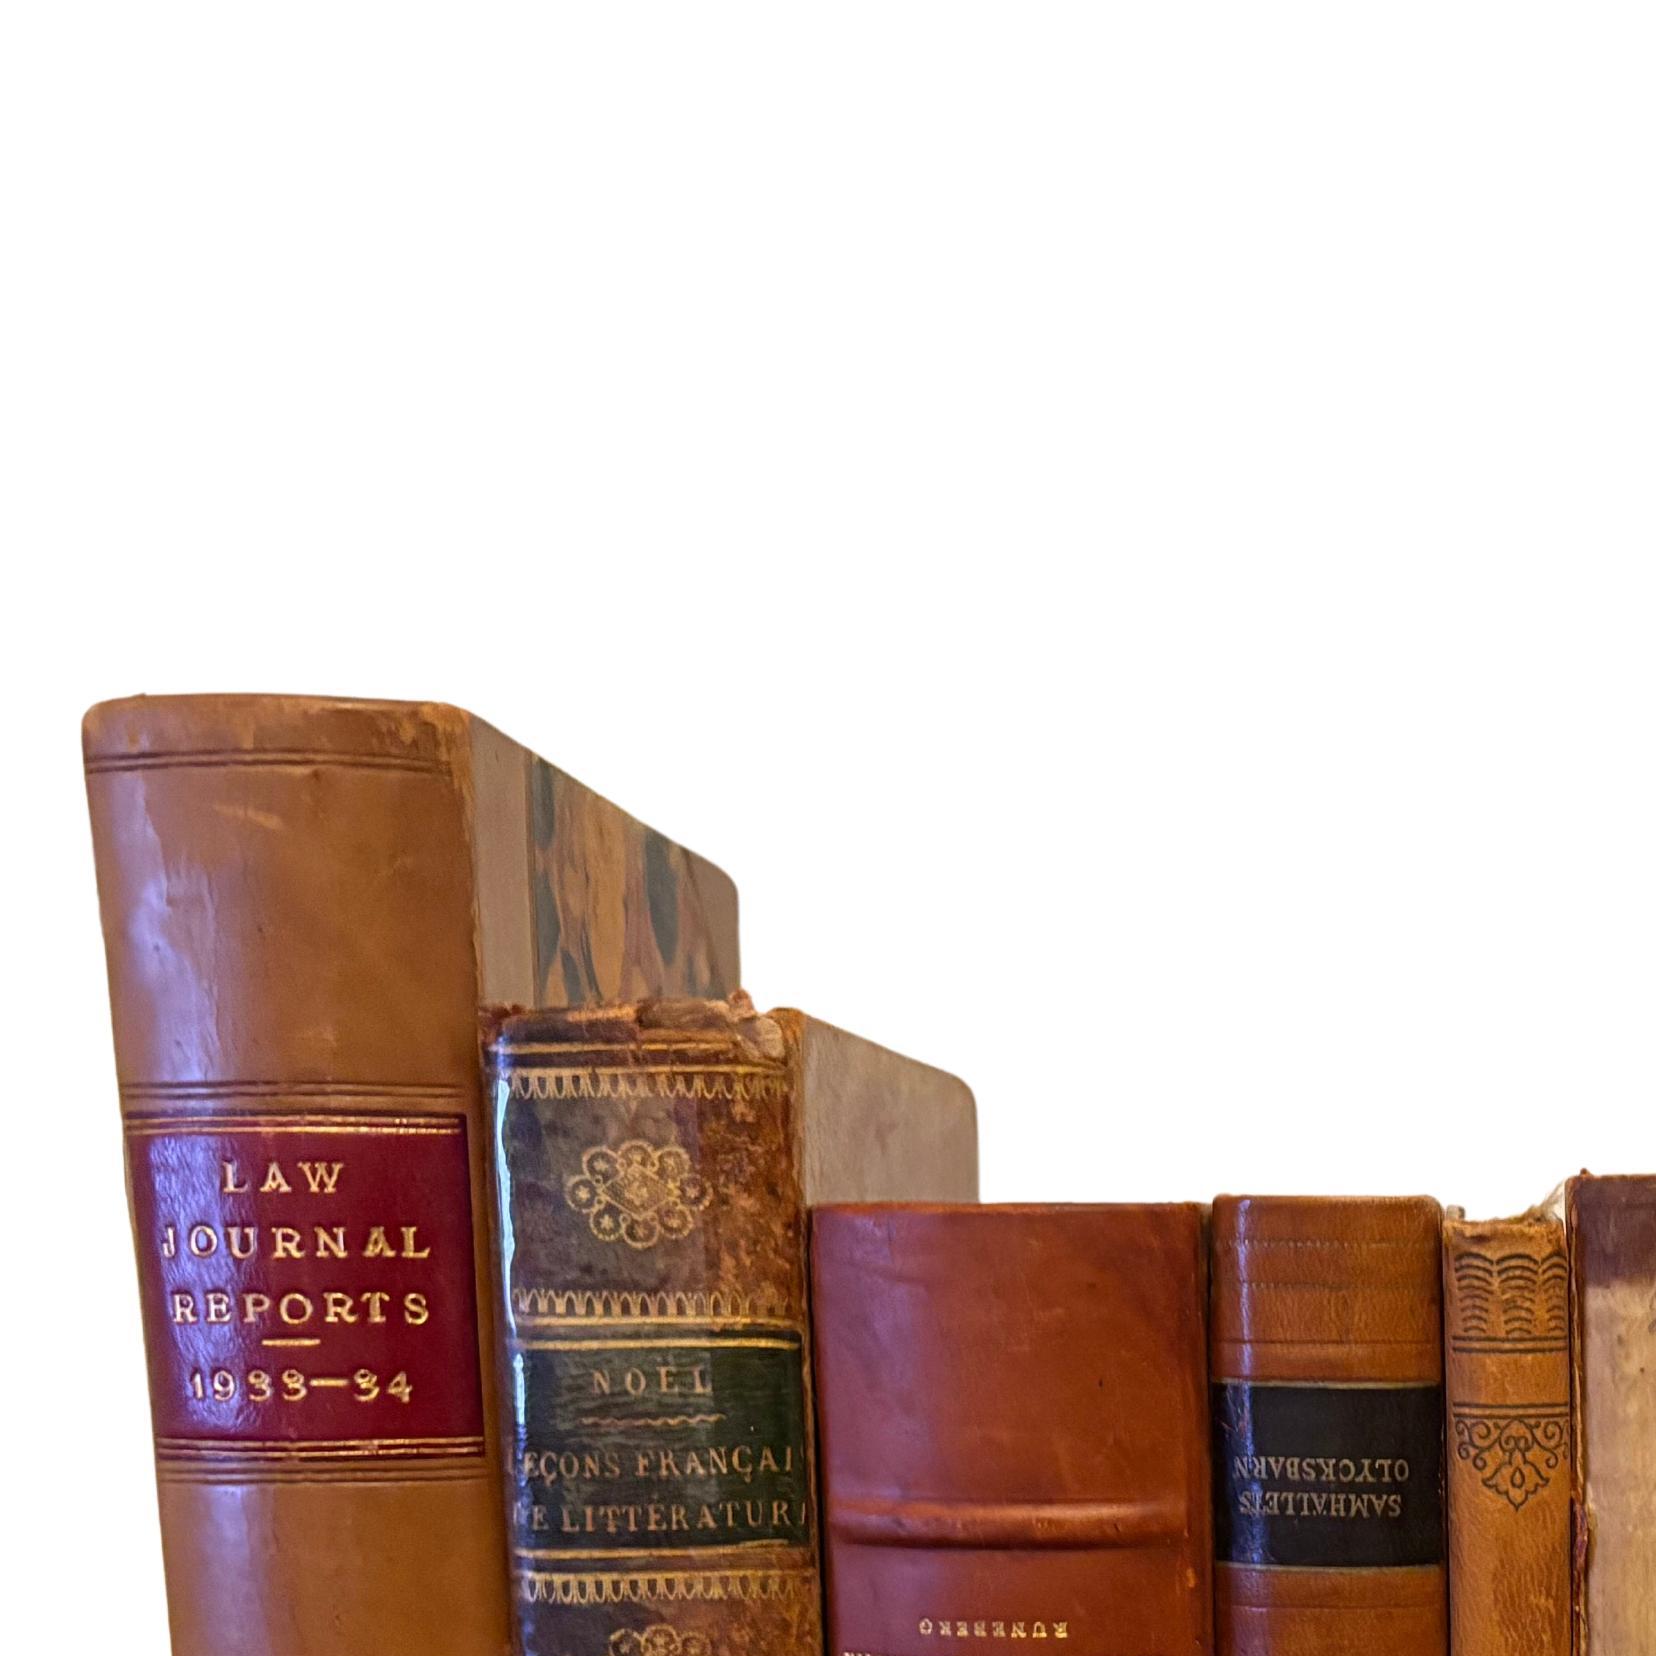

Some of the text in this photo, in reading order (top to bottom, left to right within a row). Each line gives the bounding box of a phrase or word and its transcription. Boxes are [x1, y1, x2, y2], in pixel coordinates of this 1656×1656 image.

[222, 1160, 344, 1194] LAW
[161, 1225, 431, 1260] JOURNAL
[171, 1292, 430, 1326] REPORTS
[634, 1445, 804, 1484] FRANÇAI
[1231, 1455, 1410, 1483] OLYCKSBARN
[917, 1617, 1069, 1640] RUNEBERG
